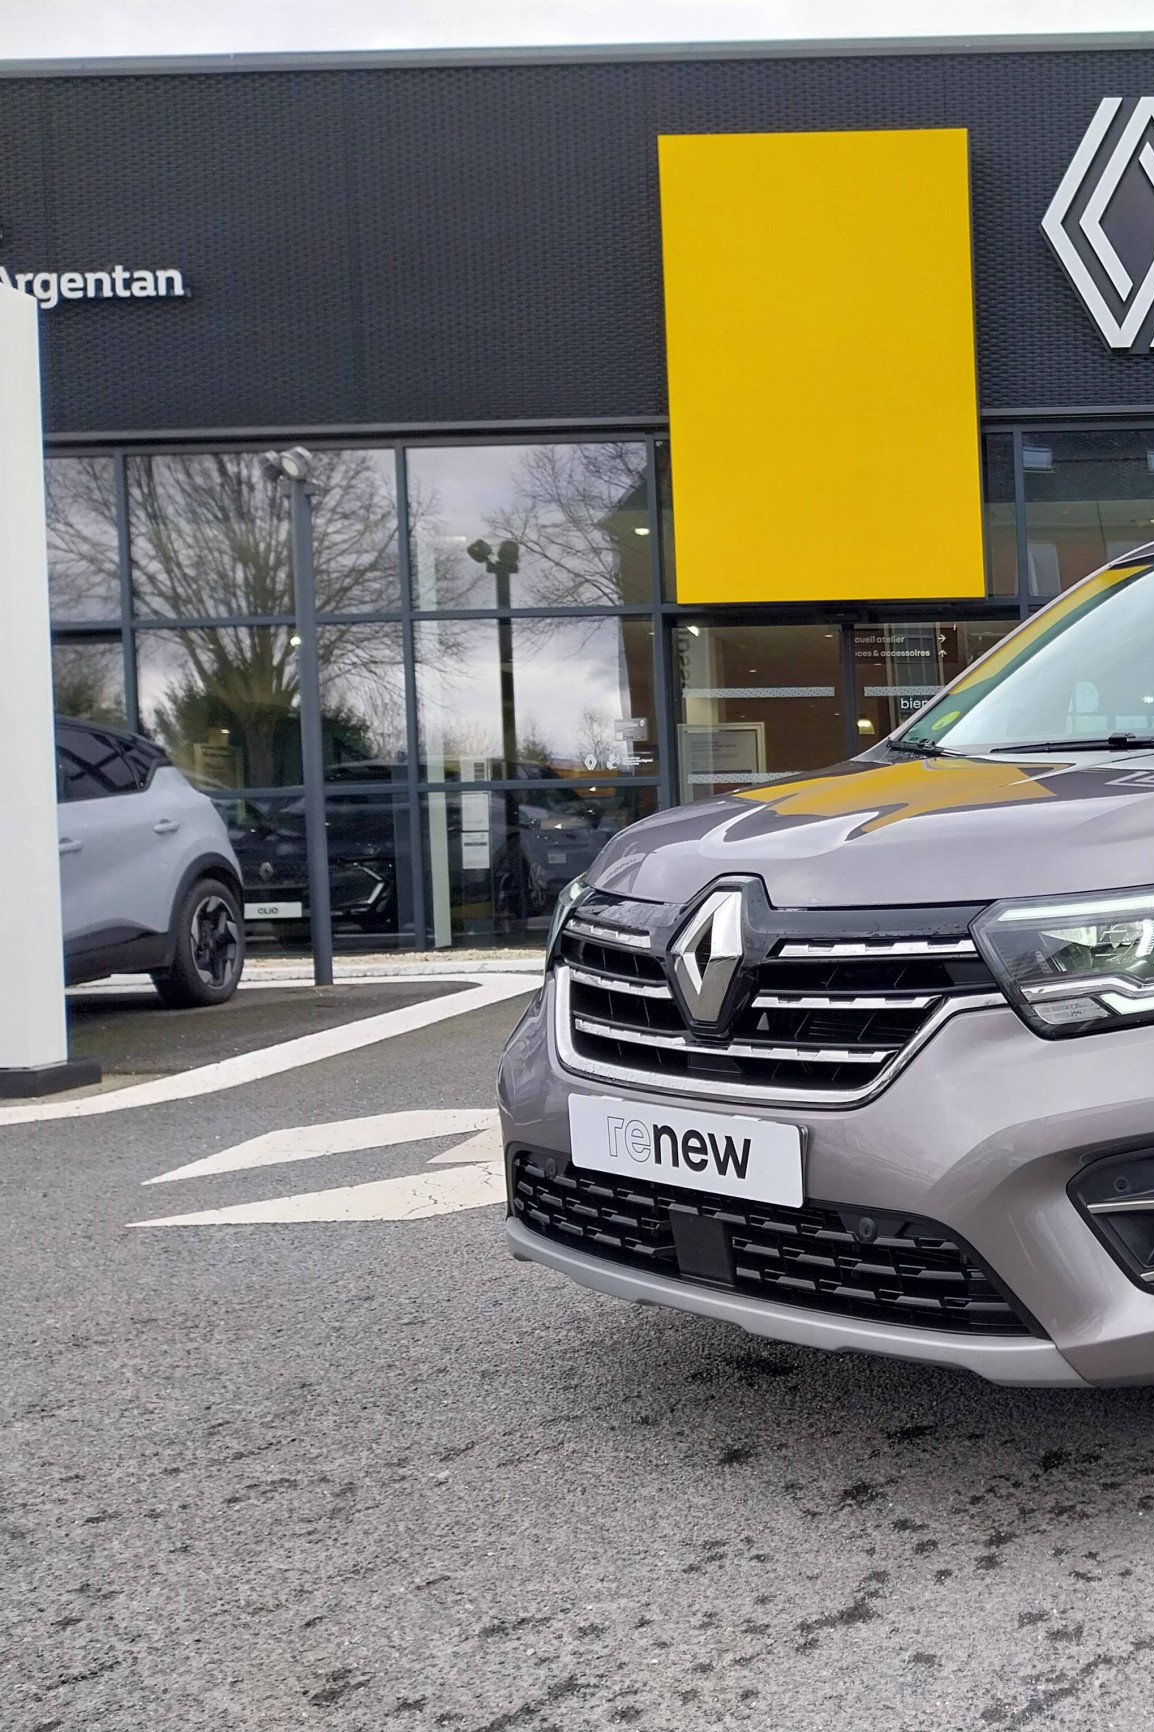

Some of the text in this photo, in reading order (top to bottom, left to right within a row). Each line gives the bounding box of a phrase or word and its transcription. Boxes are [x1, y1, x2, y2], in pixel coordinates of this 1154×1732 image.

[876, 635, 905, 643] atelier
[873, 649, 879, 657] &
[880, 648, 931, 657] accessoires
[257, 907, 279, 915] CLIO
[607, 1116, 752, 1180] renew
